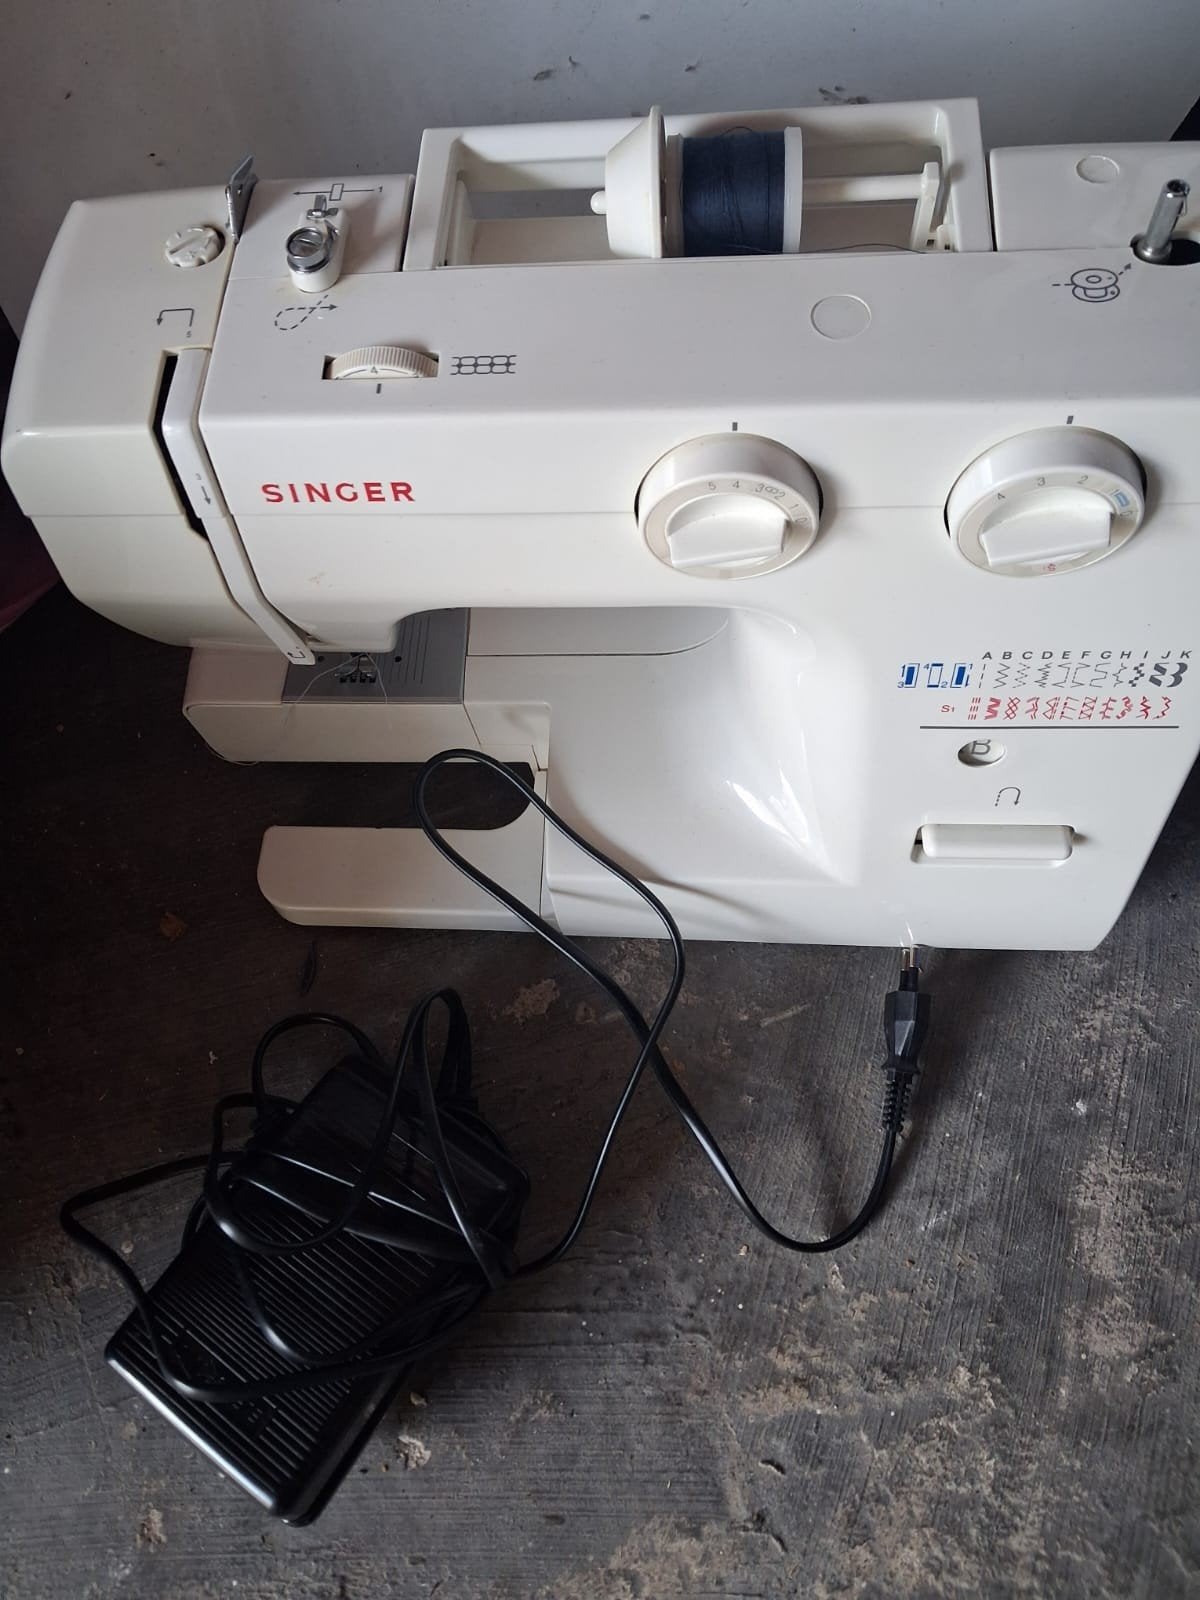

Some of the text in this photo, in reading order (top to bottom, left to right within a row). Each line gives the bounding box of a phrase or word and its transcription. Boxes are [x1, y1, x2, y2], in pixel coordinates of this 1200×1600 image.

[1037, 476, 1046, 487] 3
[1077, 474, 1089, 485] 2
[261, 482, 415, 503] SINGER
[708, 481, 717, 491] 5
[732, 480, 740, 489] 4
[755, 483, 765, 493] 3
[774, 491, 786, 500] 2
[982, 650, 1193, 660] A B C D E F G H I J K
